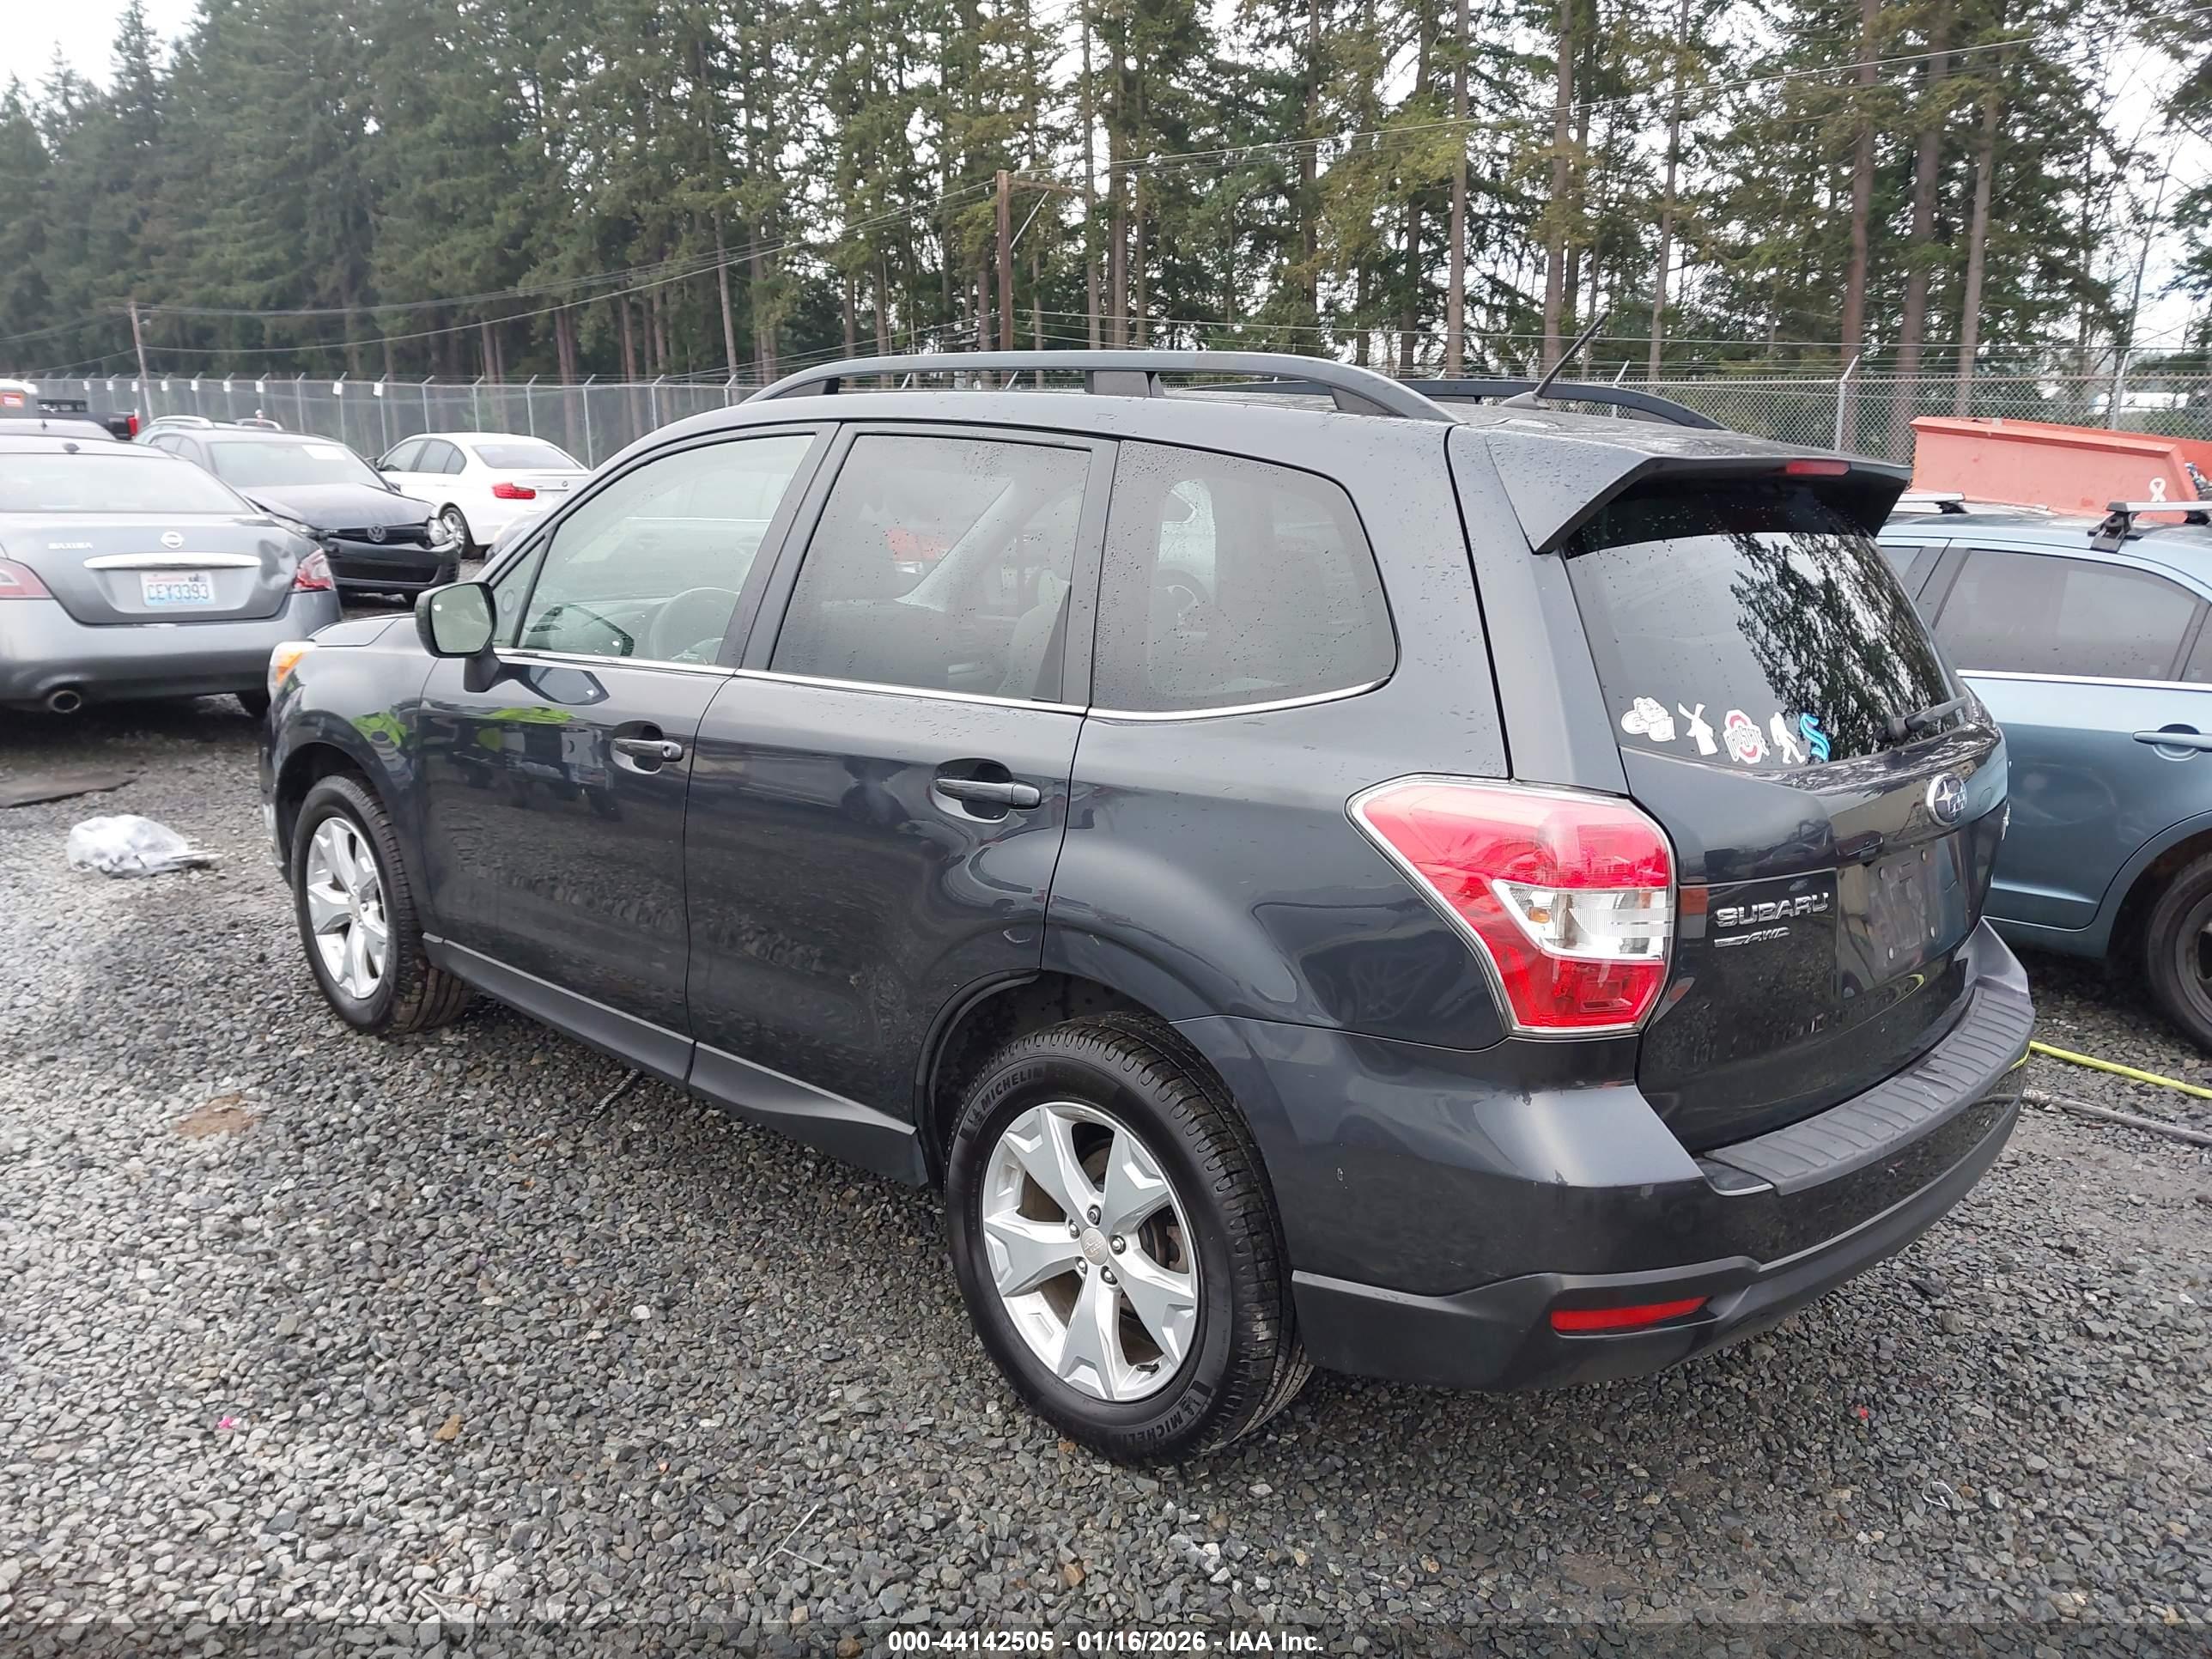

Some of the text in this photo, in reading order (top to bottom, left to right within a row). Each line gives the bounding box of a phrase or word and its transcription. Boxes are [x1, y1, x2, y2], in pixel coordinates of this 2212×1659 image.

[148, 584, 209, 599] CEY3393
[1716, 892, 1829, 927] SUBARU
[981, 1066, 1045, 1112] MICHELIN
